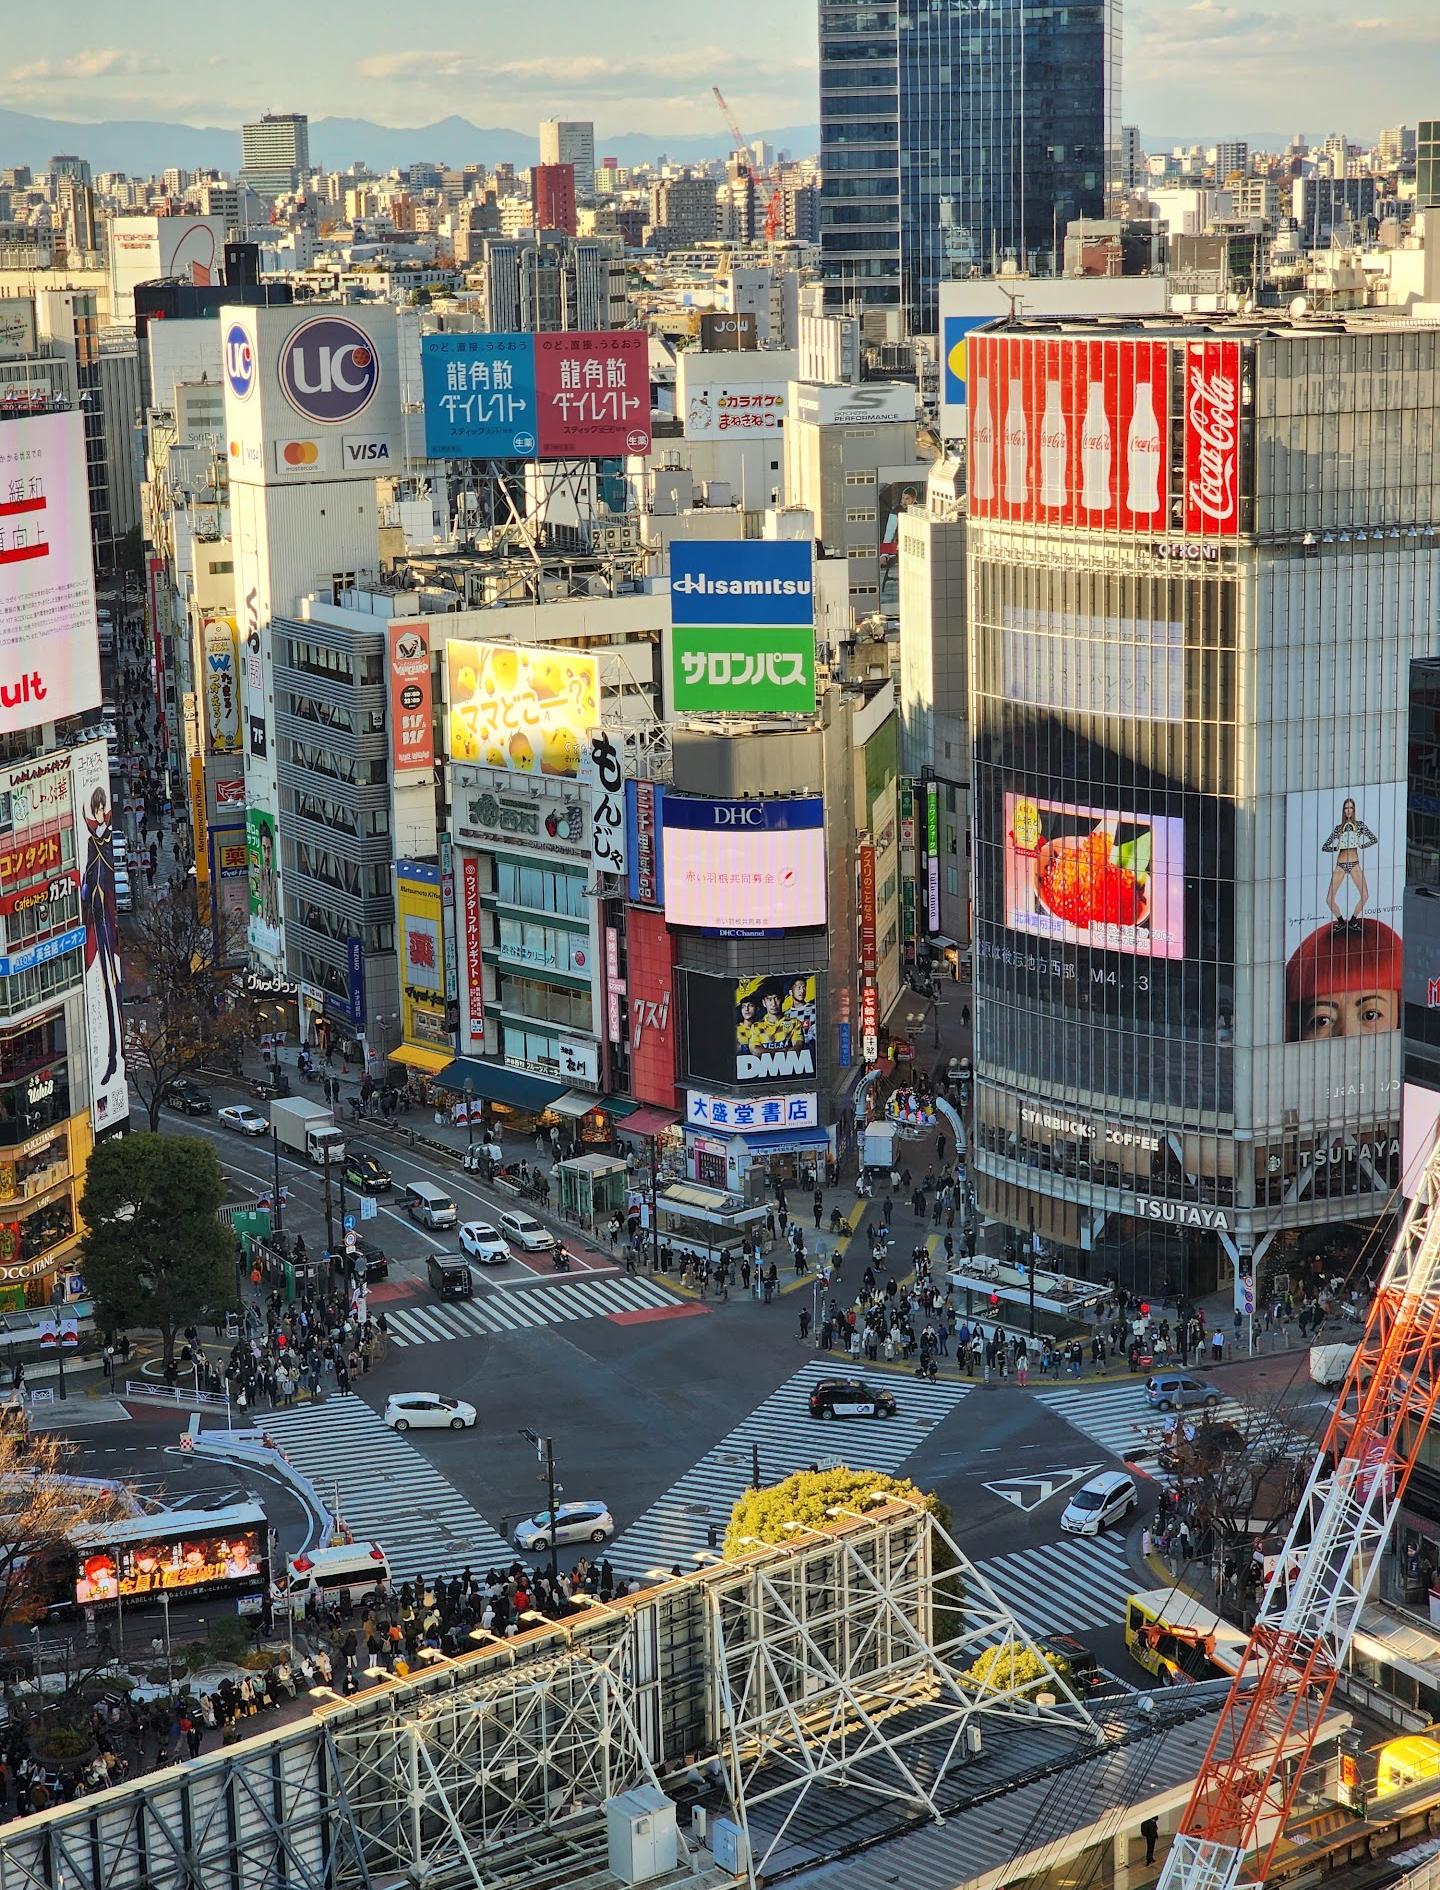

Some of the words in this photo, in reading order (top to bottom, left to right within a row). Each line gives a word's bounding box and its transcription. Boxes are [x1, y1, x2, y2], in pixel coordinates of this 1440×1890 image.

[228, 343, 251, 379] UC
[293, 344, 370, 394] UC
[446, 359, 513, 391] 龍角散
[560, 358, 627, 389] 龍角散
[439, 393, 526, 423] ダイレクト
[552, 391, 641, 421] ダイレクト
[726, 395, 777, 408] カラオケ
[719, 413, 775, 430] まねきねこ
[834, 414, 900, 422] PERFORMANCE
[346, 443, 390, 460] VISA
[627, 435, 647, 447] 生薬
[672, 573, 811, 595] Hisamitsu
[681, 651, 807, 686] サロンパス
[0, 671, 48, 709] ult
[252, 727, 264, 744] 7F
[592, 731, 625, 871] もんじゃ
[713, 807, 763, 825] DHC
[0, 839, 59, 876] コンタクト
[225, 848, 246, 866] 薬
[637, 787, 652, 898] 三千里薬品
[49, 876, 76, 902] ガスト
[685, 870, 776, 885] 赤い羽根共同募金
[719, 929, 735, 937] DHC
[735, 929, 765, 937] Channel
[863, 926, 876, 971] 三千里
[247, 973, 298, 994] グルメタウン
[633, 991, 671, 1050] クスリ
[736, 1049, 815, 1080] DMM
[694, 1098, 808, 1125] 大盛堂書店
[1021, 1107, 1096, 1140] STARBUCKS
[1105, 1129, 1160, 1152] COFFEE
[1300, 1139, 1401, 1168] TSUTAYA
[1136, 1197, 1229, 1230] TSUTAYA
